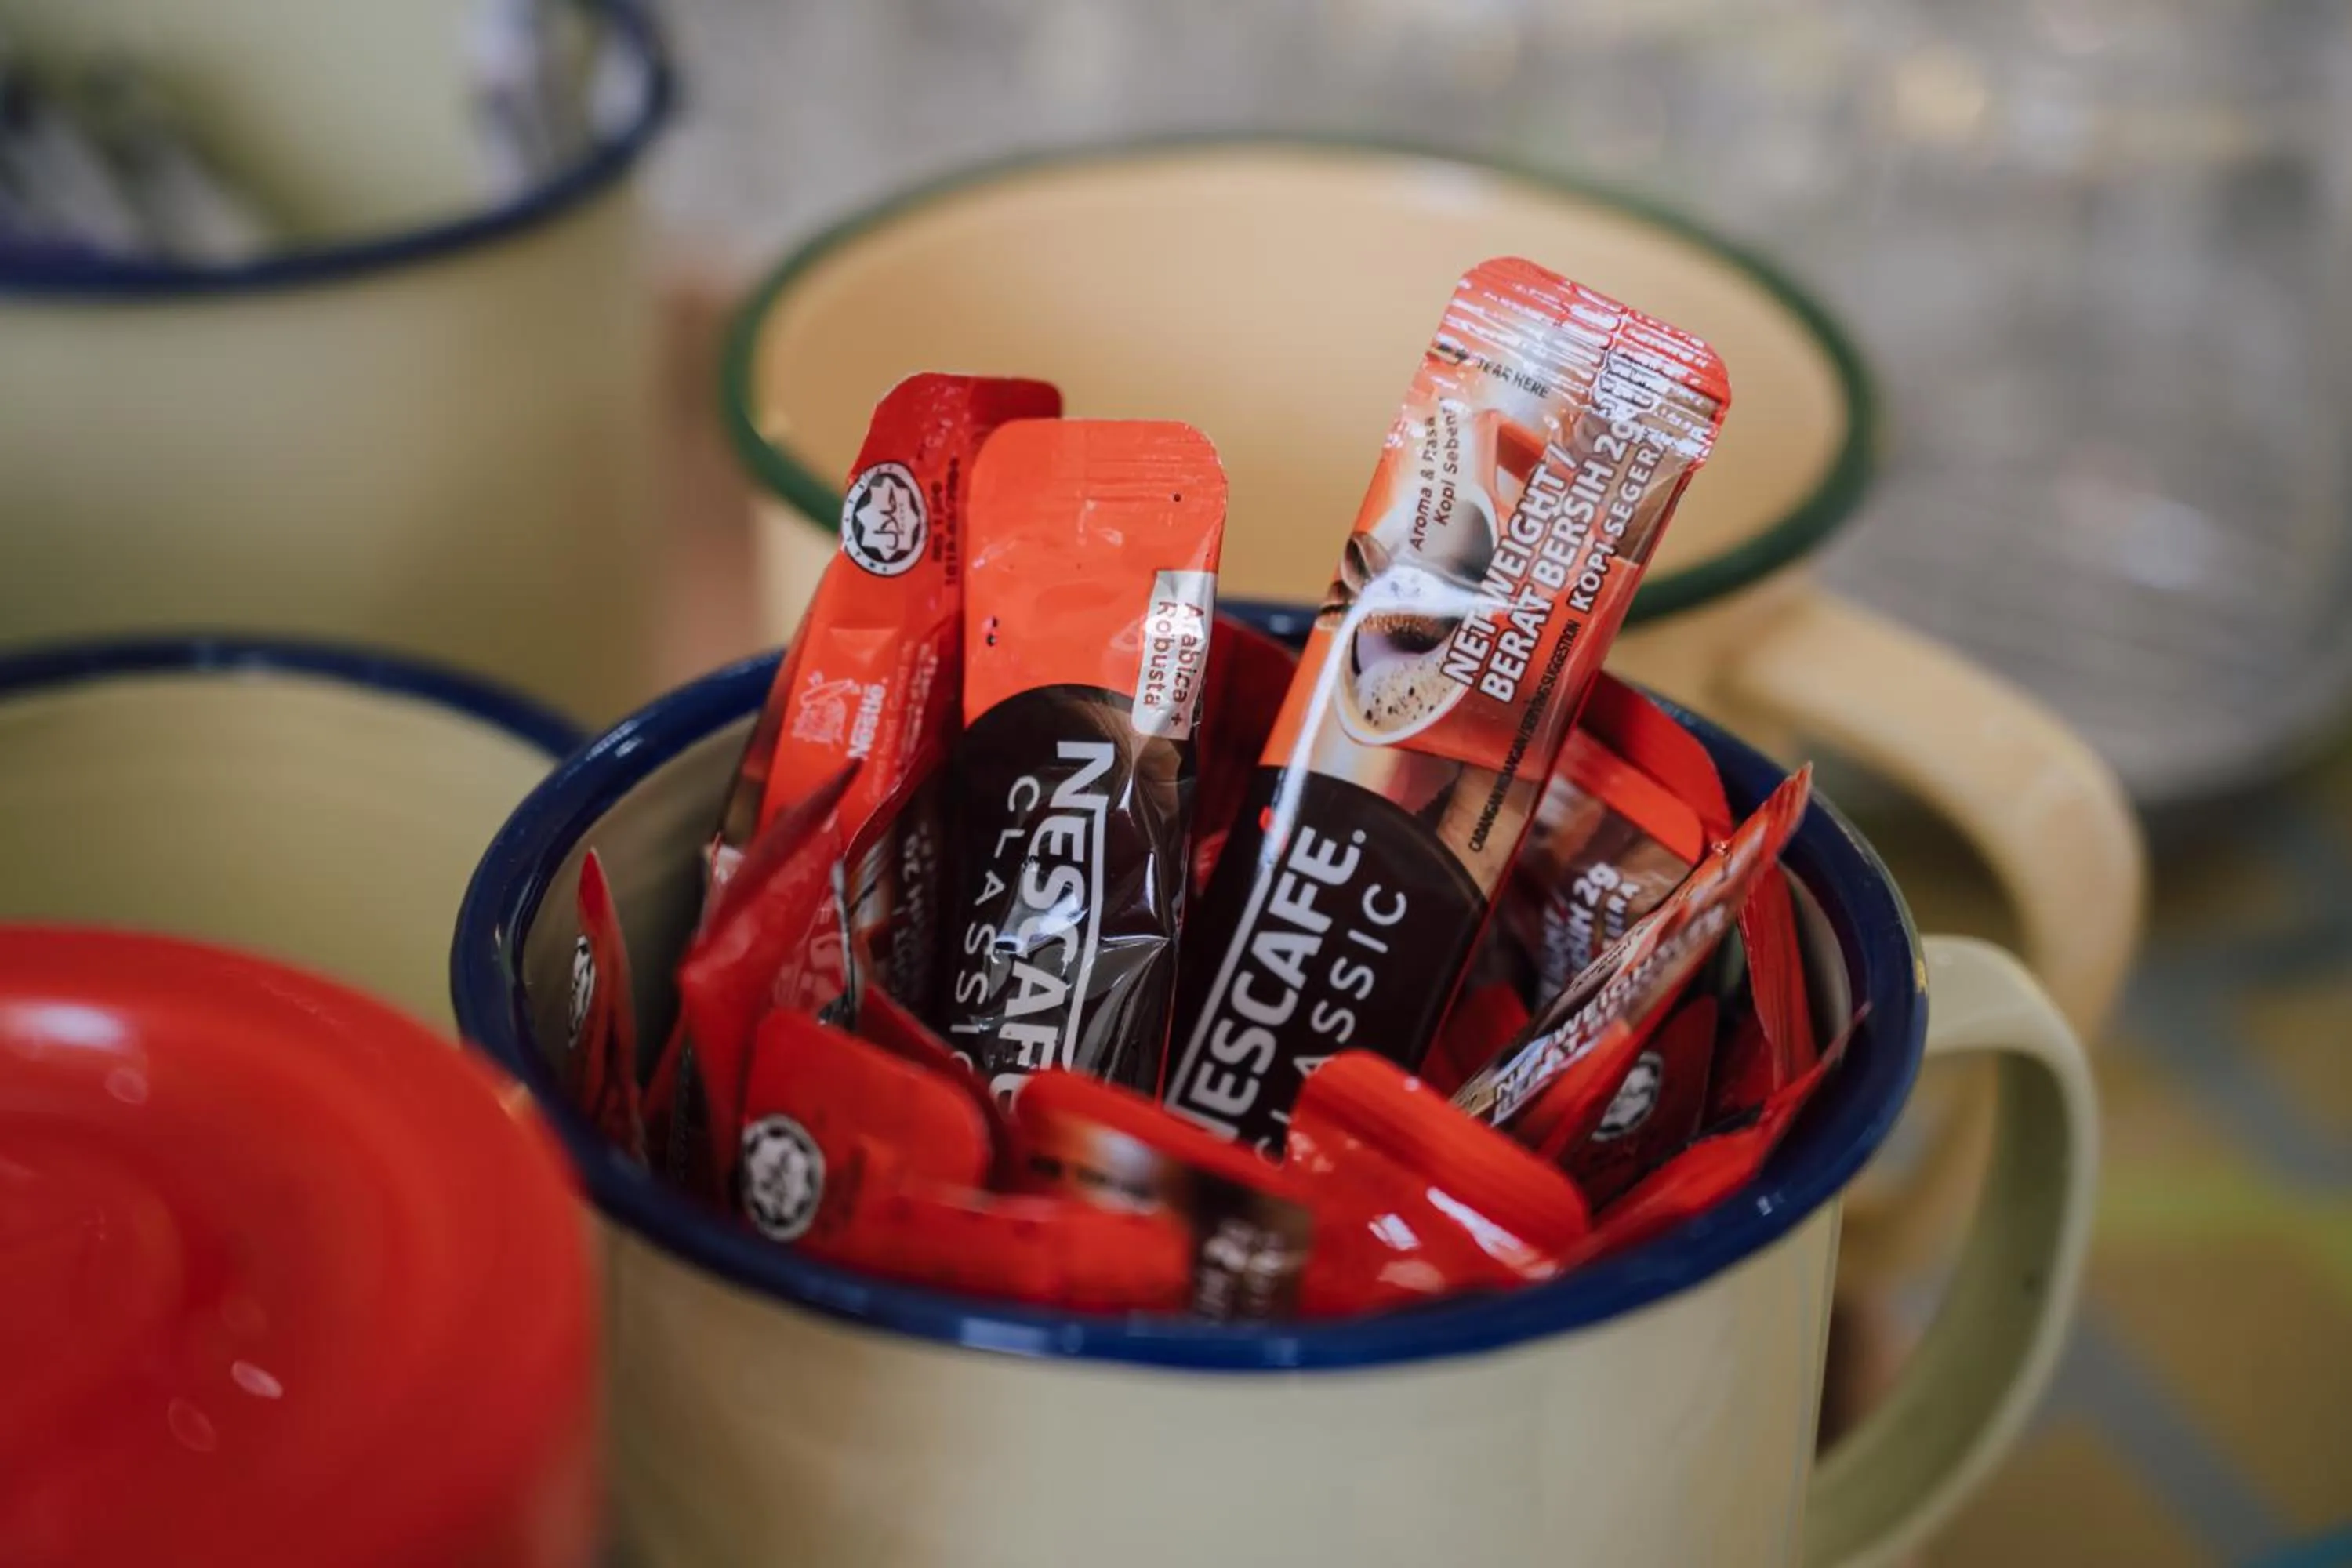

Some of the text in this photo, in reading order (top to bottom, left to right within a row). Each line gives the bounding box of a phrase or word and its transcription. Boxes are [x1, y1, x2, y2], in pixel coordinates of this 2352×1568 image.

[1515, 372, 1551, 399] HERE
[1433, 397, 1458, 527] Kopi Seben
[1409, 487, 1433, 552] Aroma
[1479, 420, 1646, 702] BERAT BERSIH 2g
[1442, 608, 1497, 684] NET
[1480, 463, 1565, 608] WEIGHT
[1570, 542, 1615, 612] KOPI
